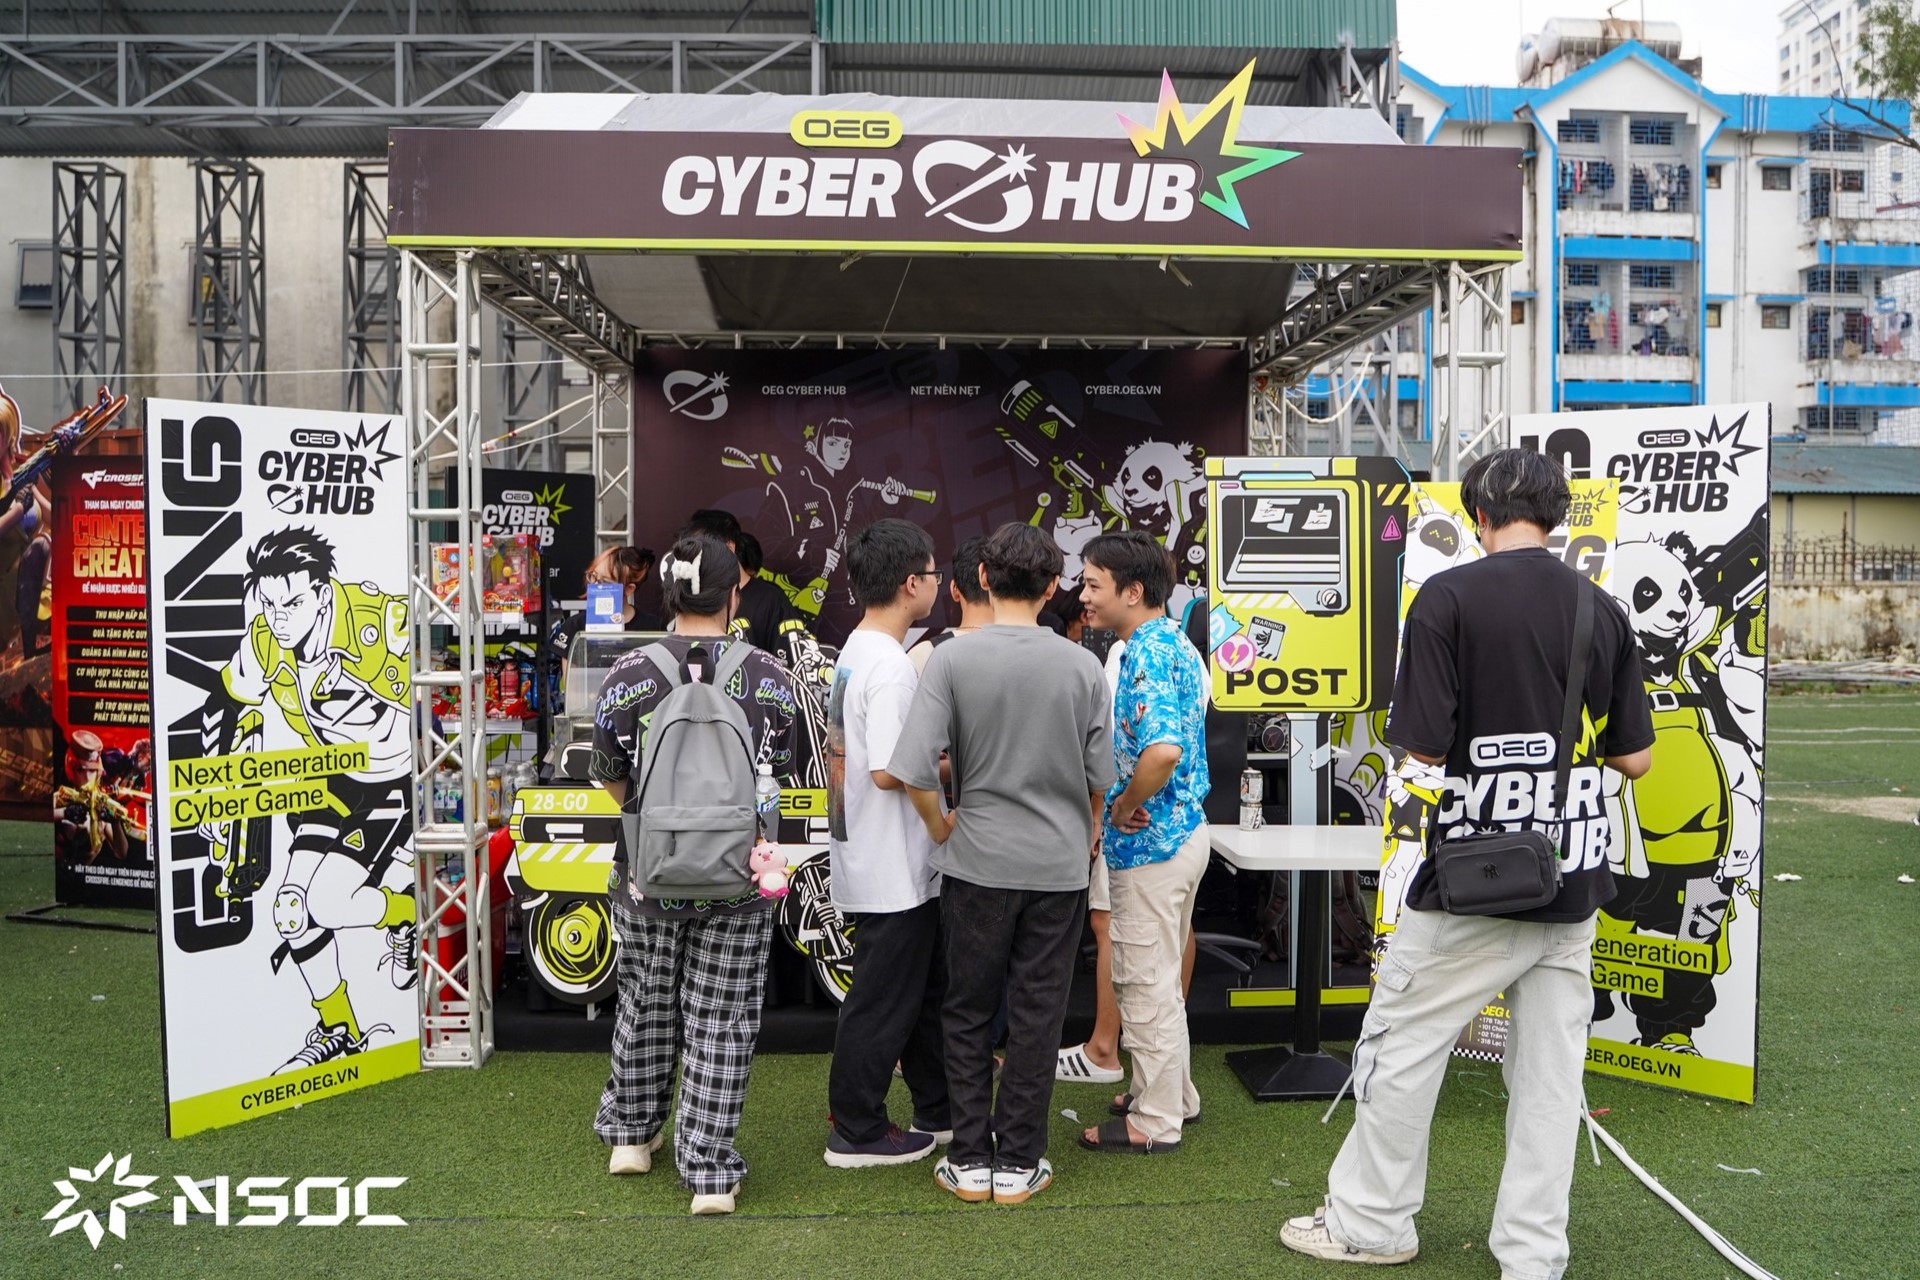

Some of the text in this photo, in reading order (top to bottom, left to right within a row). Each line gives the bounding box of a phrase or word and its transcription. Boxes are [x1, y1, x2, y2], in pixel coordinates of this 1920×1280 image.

[804, 119, 890, 139] OEG
[661, 155, 1197, 222] CYBER HUB
[762, 385, 847, 395] OEG CYBER HUB
[911, 385, 931, 395] NET
[1085, 385, 1161, 395] CYBER.OEG.VN
[296, 432, 337, 445] OEG
[1643, 433, 1685, 445] OEG
[258, 451, 367, 484] CYBER
[1607, 451, 1721, 483] CYBER
[110, 500, 125, 510] NGAY
[305, 484, 375, 515] HUB
[1653, 482, 1729, 513] HUB
[482, 504, 550, 526] CYBER
[96, 610, 108, 620] THU
[108, 609, 125, 621] NHẬP
[125, 608, 138, 620] HẤP
[1254, 617, 1284, 631] WARNING
[93, 627, 105, 638] QUÀ
[107, 628, 122, 640] TẶNG
[123, 628, 135, 640] ĐỘC
[82, 646, 102, 657] QUẢNG
[103, 647, 111, 657] BÁ
[112, 648, 127, 658] HÌNH
[128, 648, 141, 658] ẢNH
[77, 667, 86, 676] CƠ
[86, 666, 97, 679] HỘI
[98, 668, 111, 679] HỢP
[112, 667, 123, 678] TÁC
[124, 668, 140, 678] CÙNG
[1226, 668, 1348, 696] POST
[95, 679, 107, 688] CỦA
[109, 679, 121, 689] NHÀ
[122, 680, 137, 690] PHÁT
[95, 698, 104, 710] HỖ
[105, 701, 117, 712] TRỢ
[94, 712, 109, 722] PHÁT
[111, 711, 127, 722] TRIỂN
[128, 714, 139, 725] NỘI
[1477, 739, 1547, 760] OEG
[174, 749, 366, 788] Next Generation
[532, 793, 589, 811] 28-GO
[1438, 766, 1602, 825] CYBER
[174, 788, 324, 825] Cyber Game
[1591, 937, 1708, 970] eneration
[1591, 963, 1659, 994] Game
[241, 1066, 359, 1111] CYBER.OEG.VN
